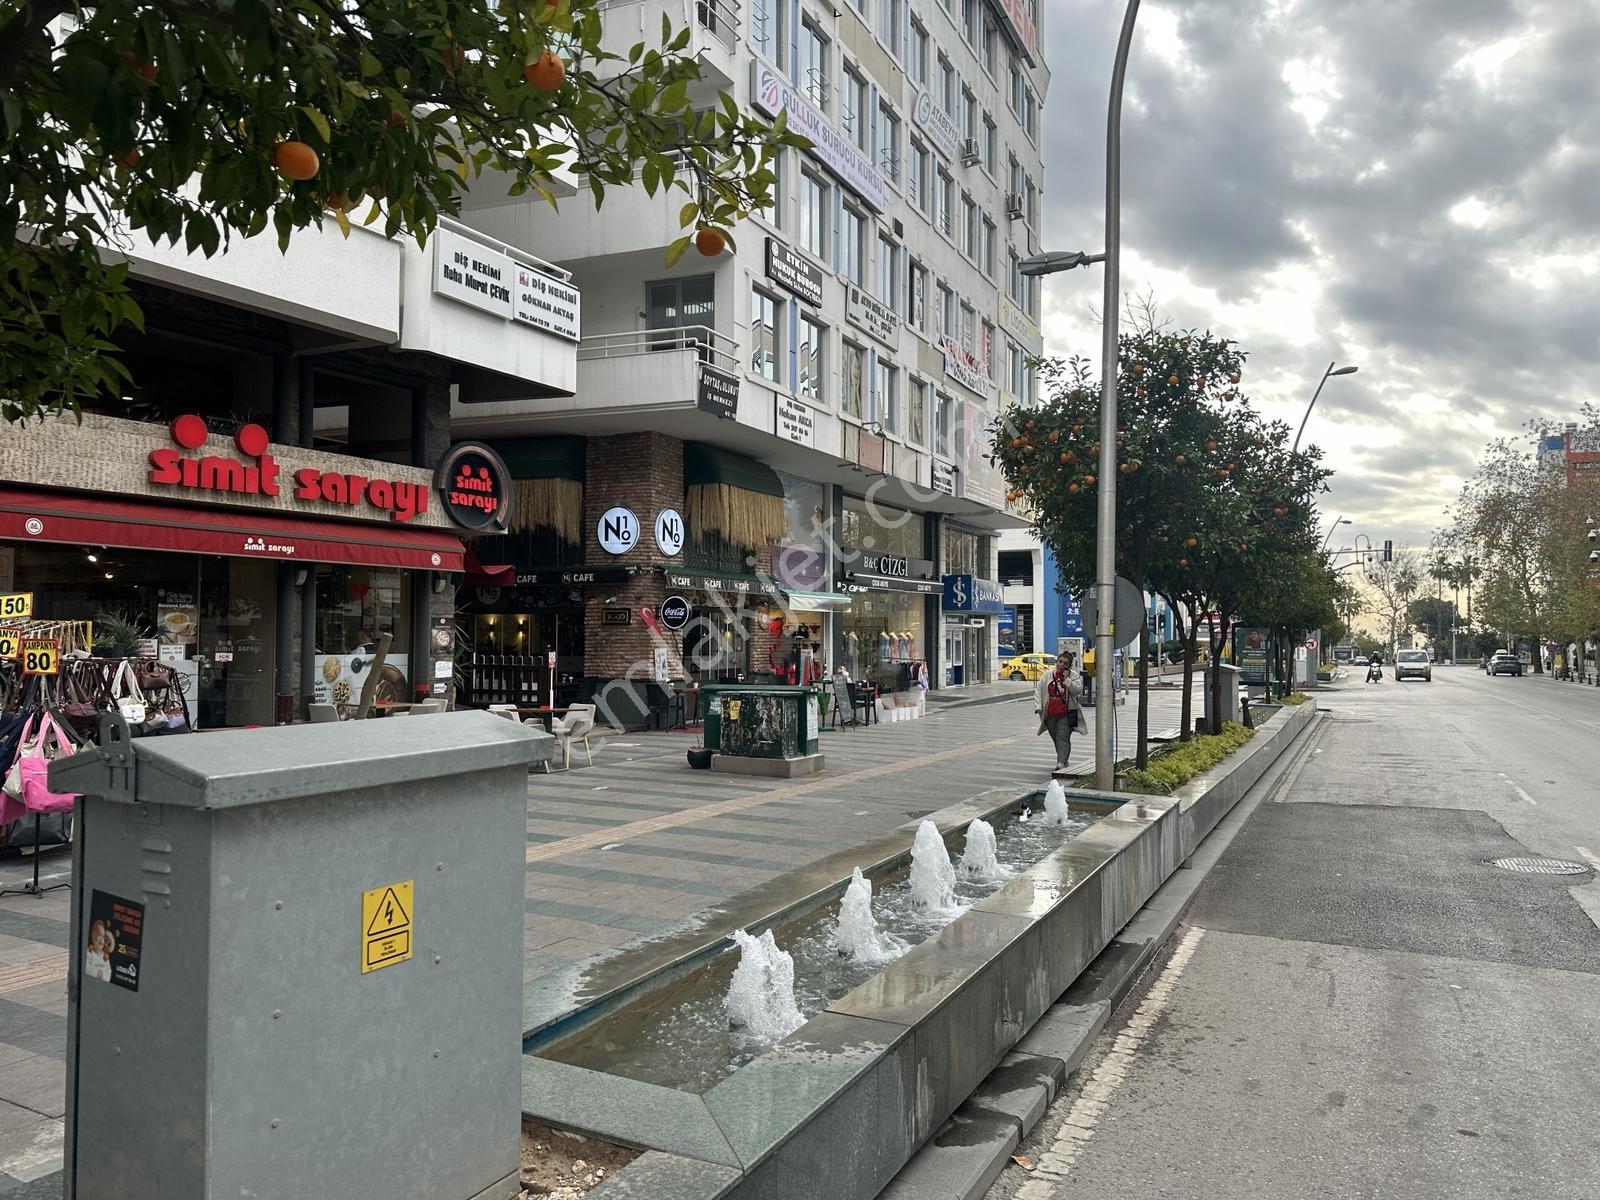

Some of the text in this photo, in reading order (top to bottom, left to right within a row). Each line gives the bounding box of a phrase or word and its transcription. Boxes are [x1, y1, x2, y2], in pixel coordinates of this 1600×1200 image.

[454, 251, 501, 281] DİŞ HEKİMİ
[786, 252, 809, 275] ETKİN
[772, 256, 821, 295] HUKUK BÜROSU
[465, 273, 488, 297] Murat
[490, 279, 510, 303] ÇEVİK
[532, 277, 545, 296] DİŞ
[522, 293, 574, 322] GÖKHAN AKTAŞ
[148, 414, 429, 523] simit sarayı
[450, 464, 498, 513] simit sarayı
[244, 537, 295, 555] simit sarayı
[517, 575, 537, 583] CAFE
[573, 573, 594, 582] CAFE
[677, 577, 690, 586] CAFE
[709, 580, 721, 588] CAFE
[0, 629, 19, 639] NYA
[24, 640, 57, 651] KAMPANYA
